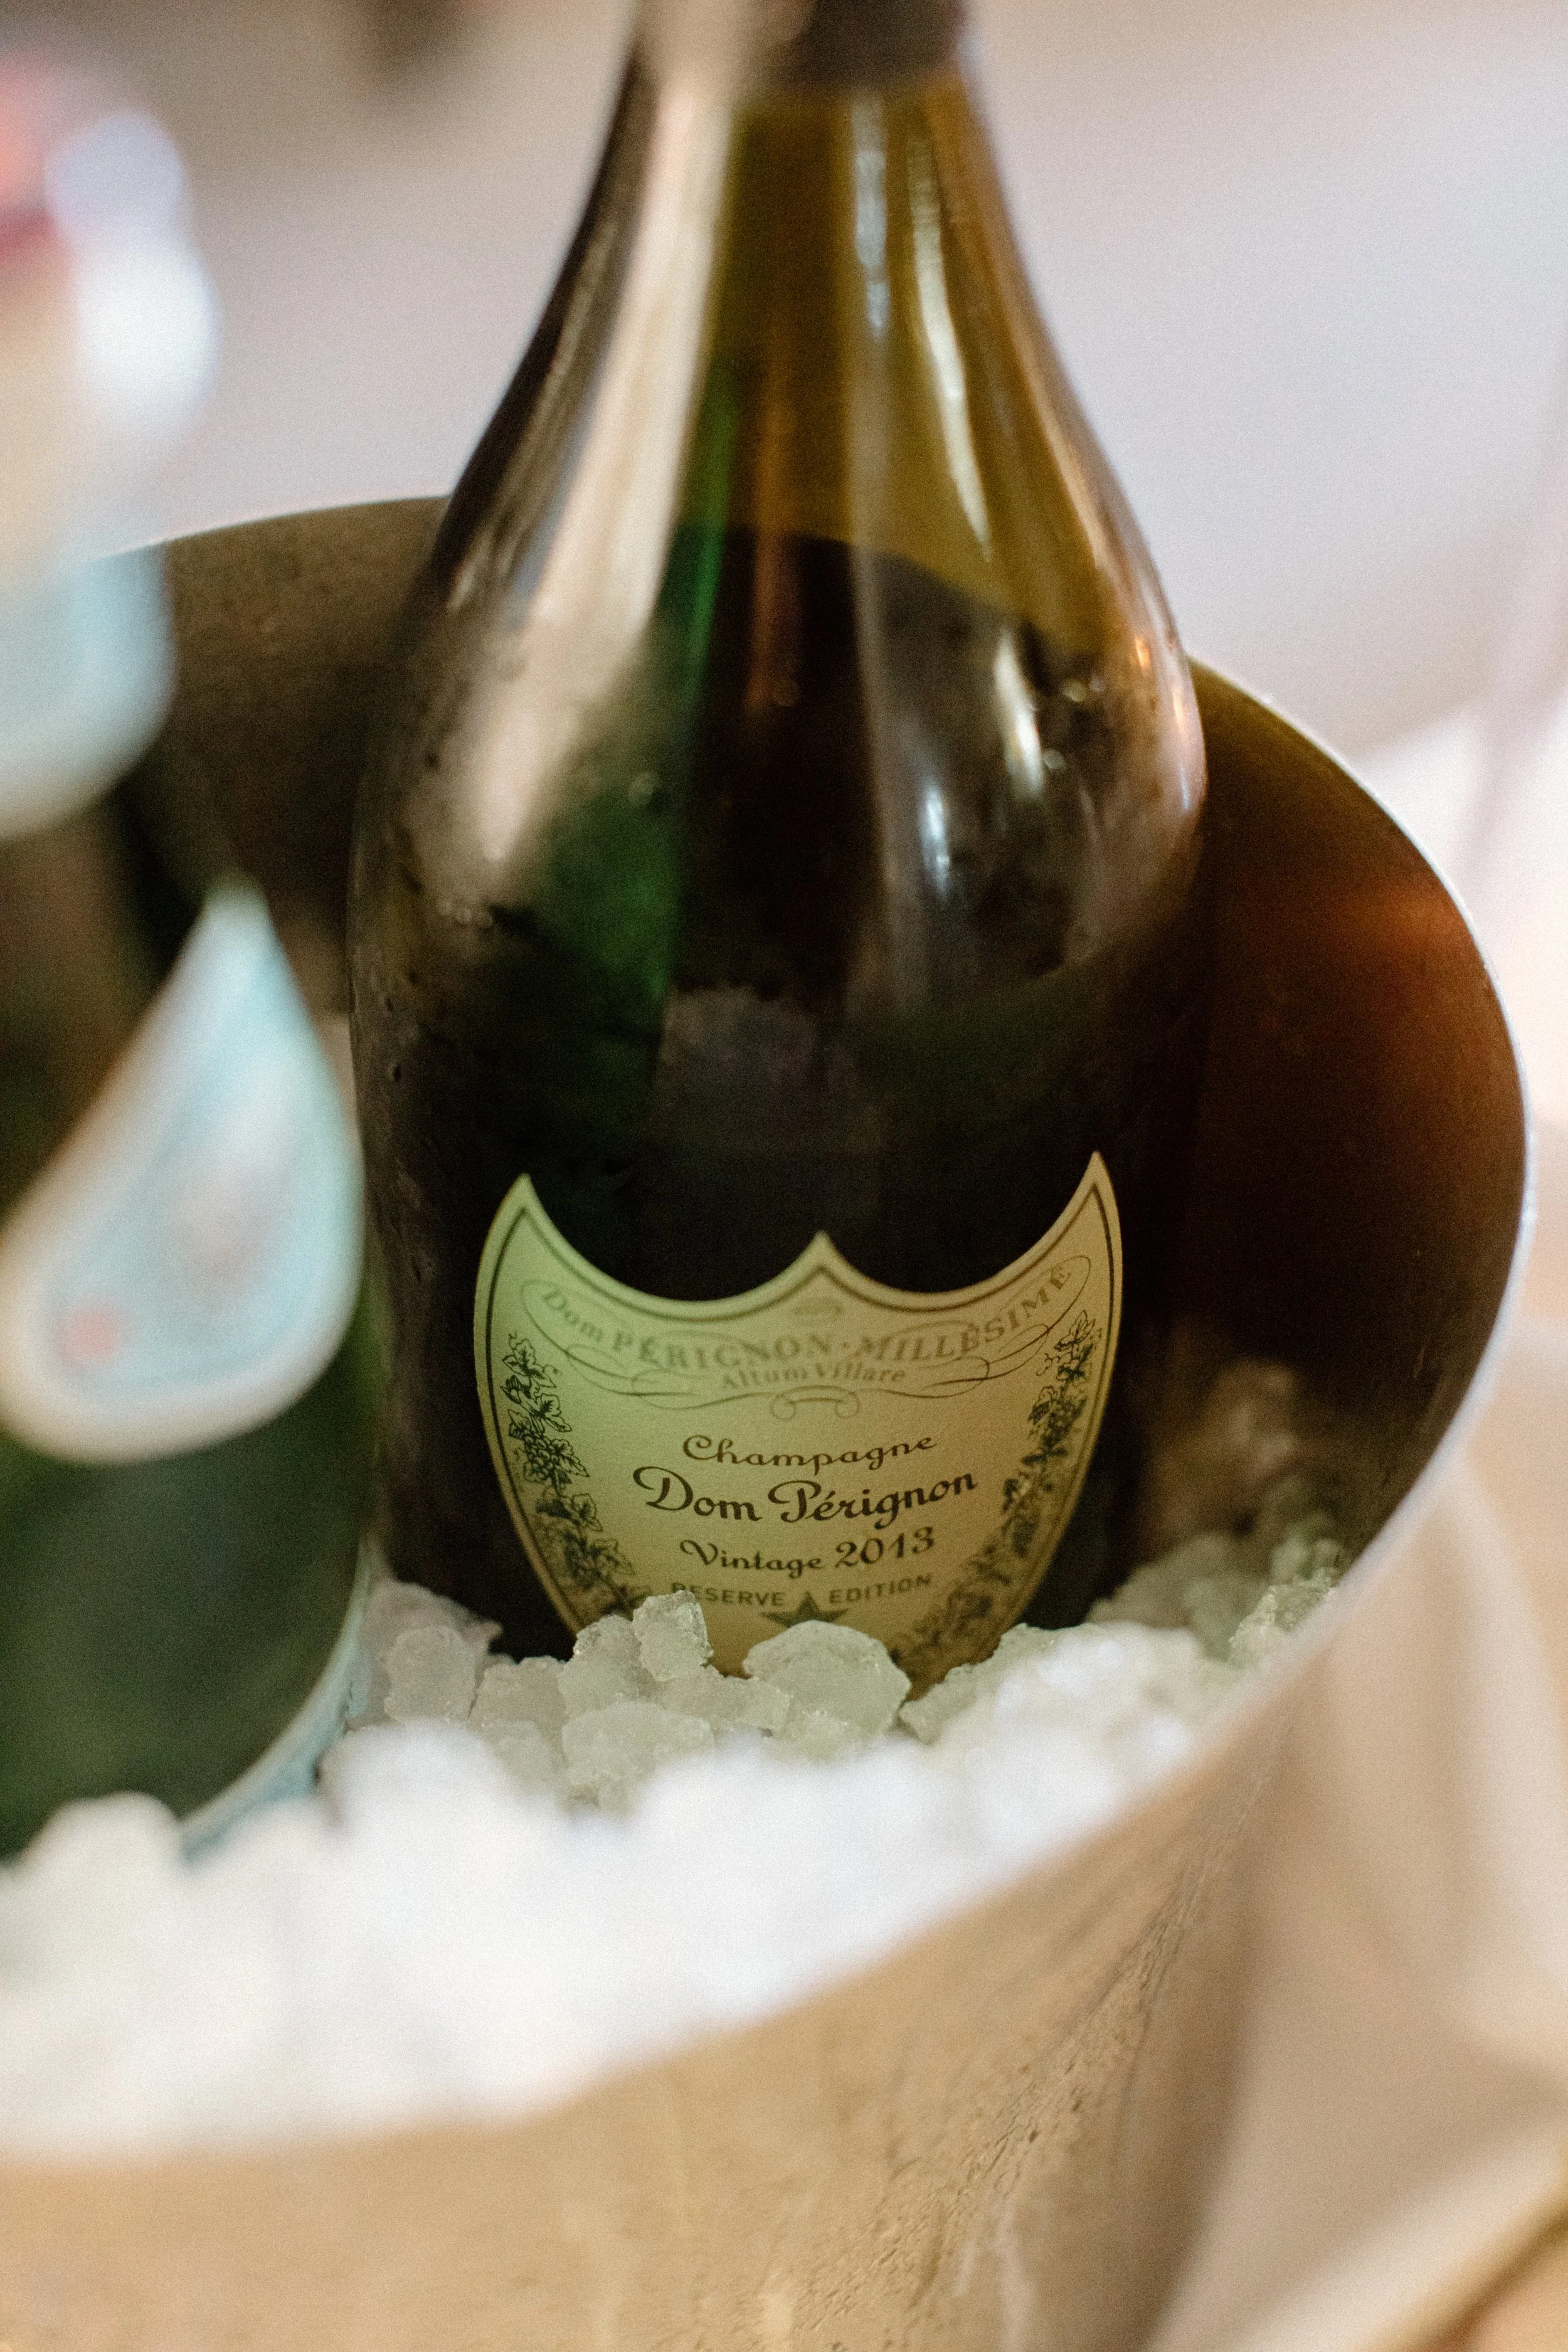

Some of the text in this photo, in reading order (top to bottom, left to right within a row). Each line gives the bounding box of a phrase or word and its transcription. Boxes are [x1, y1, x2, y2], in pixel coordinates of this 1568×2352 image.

[541, 1289, 605, 1342] Dom
[682, 1434, 937, 1476] Champagne
[632, 1465, 978, 1530] Dom Pérignon
[679, 1526, 935, 1579] Vintage 2013
[829, 1572, 932, 1604] EDITION
